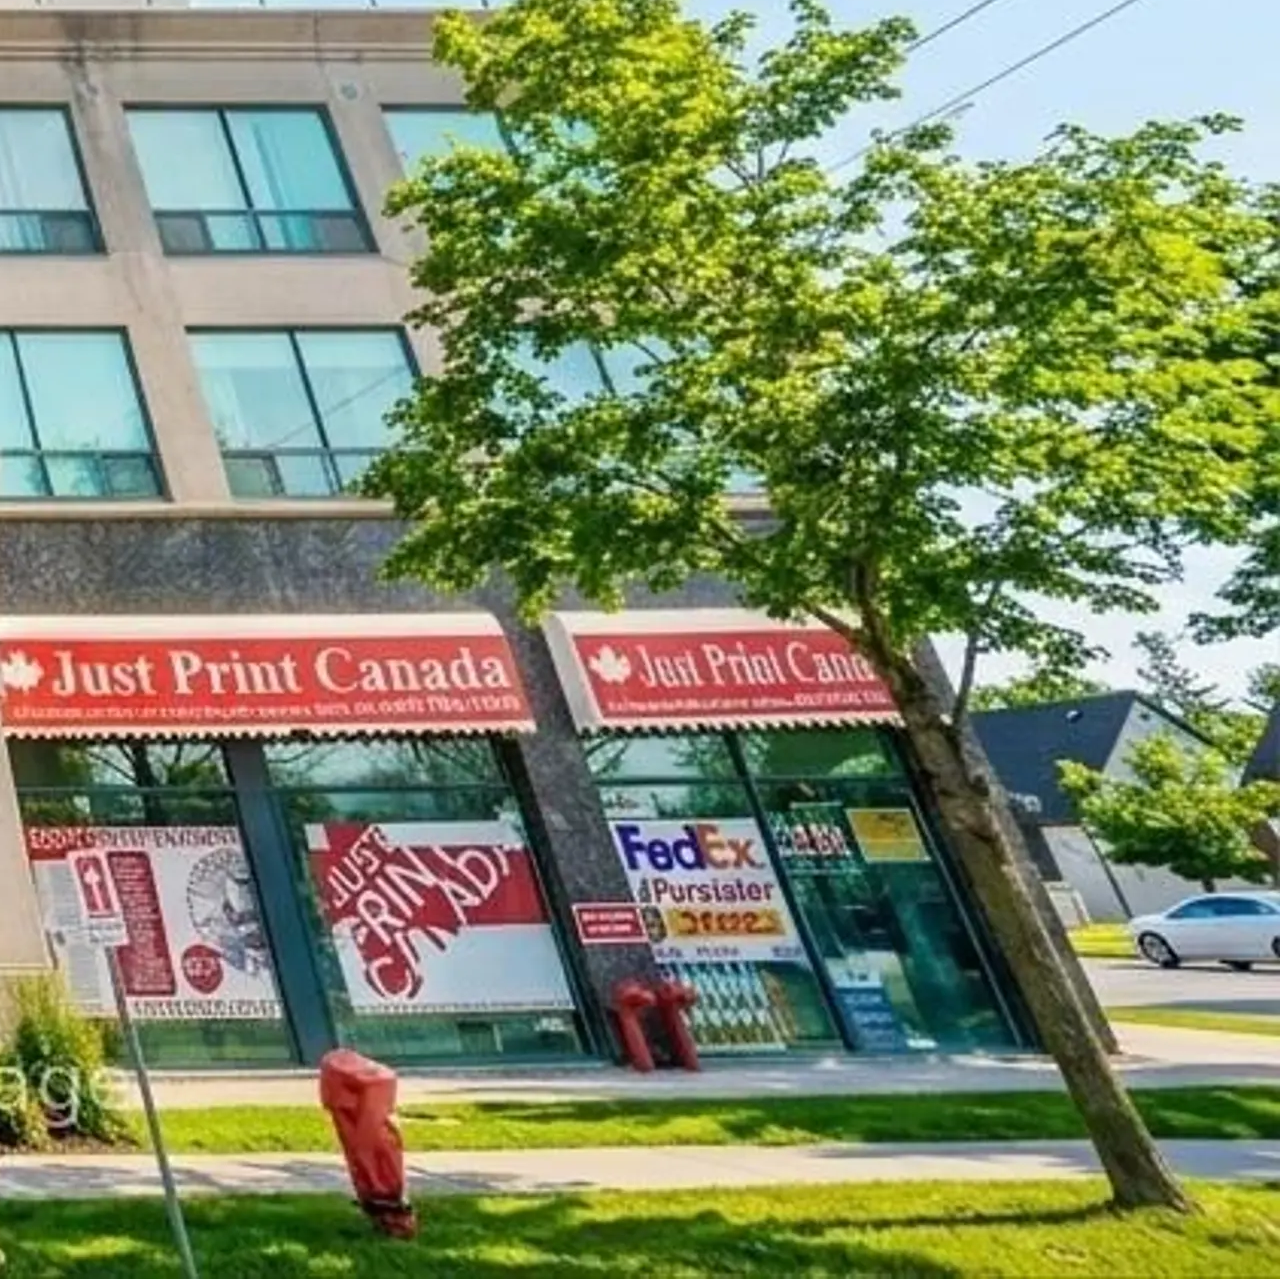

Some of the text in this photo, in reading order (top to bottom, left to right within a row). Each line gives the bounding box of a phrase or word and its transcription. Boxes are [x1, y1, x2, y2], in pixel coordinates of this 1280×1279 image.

[51, 646, 513, 698] Just Print Canada
[636, 644, 704, 689] Just
[786, 640, 878, 684] Cana
[327, 825, 391, 908] JUST
[615, 824, 760, 870] FedEx
